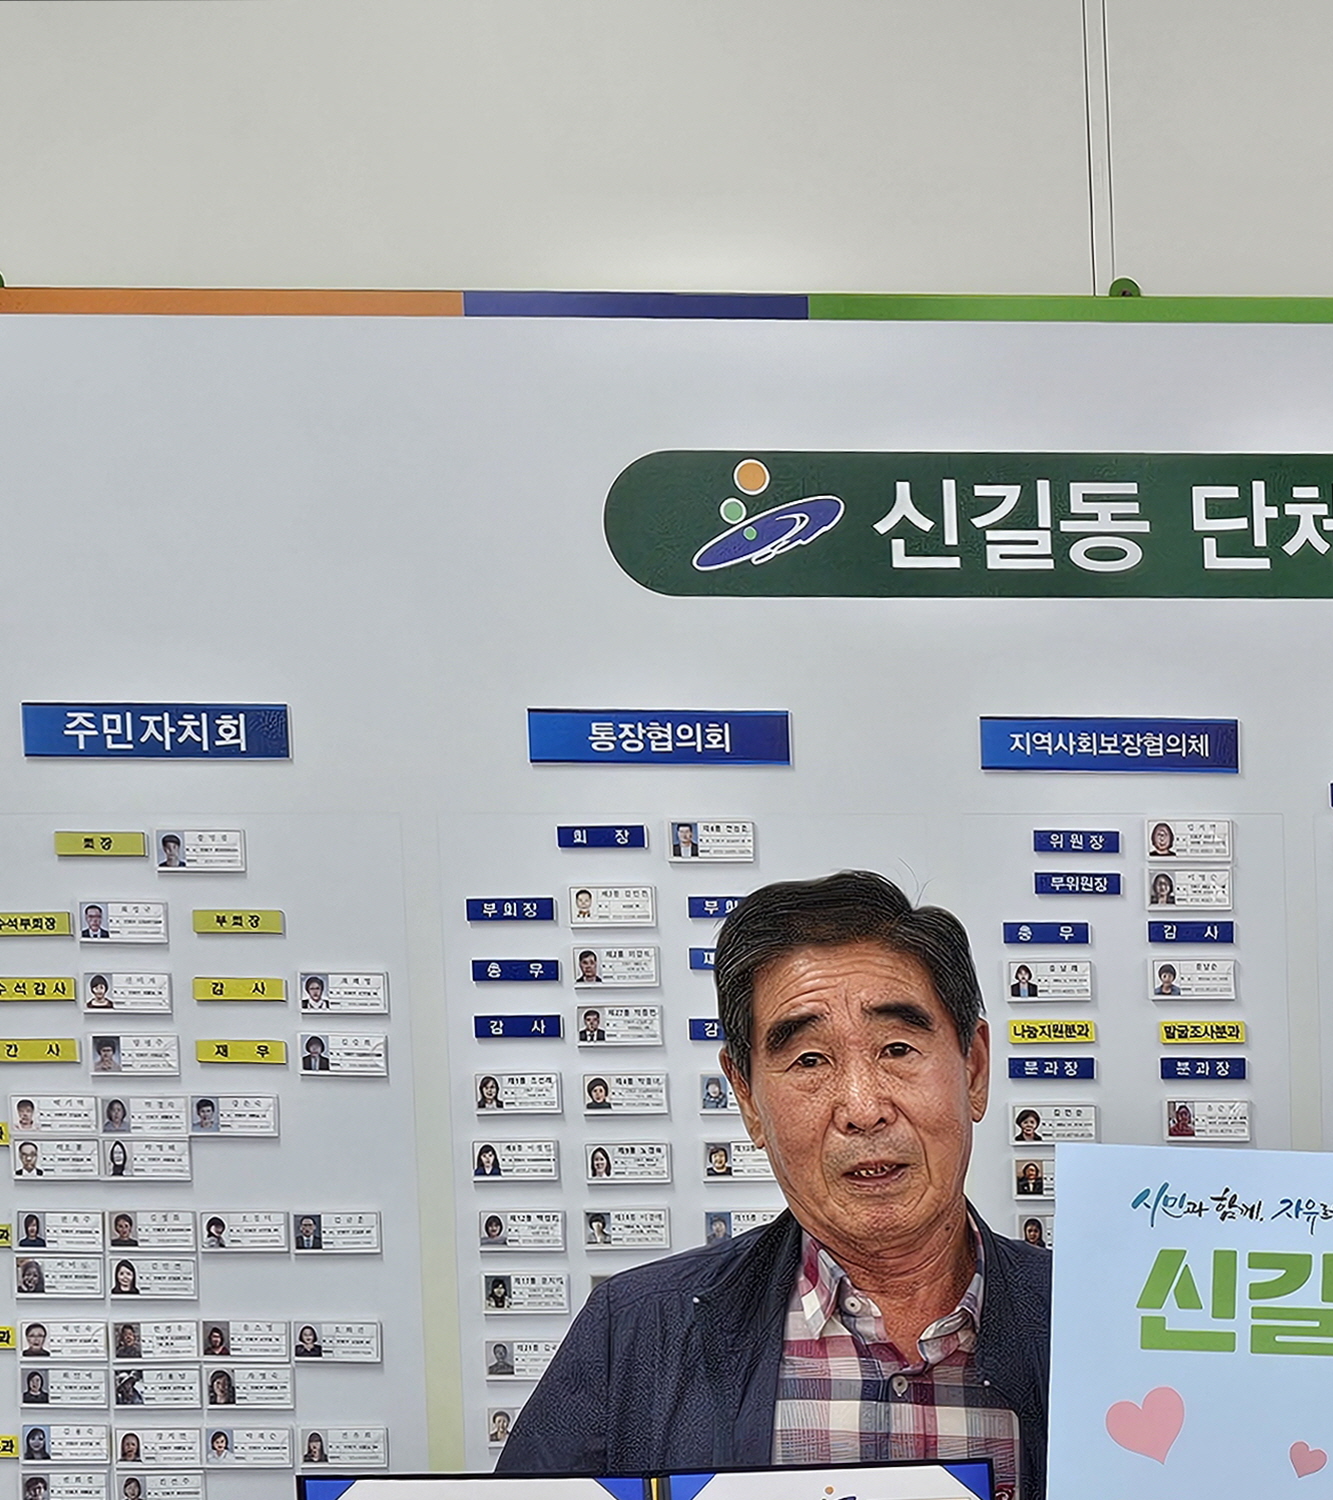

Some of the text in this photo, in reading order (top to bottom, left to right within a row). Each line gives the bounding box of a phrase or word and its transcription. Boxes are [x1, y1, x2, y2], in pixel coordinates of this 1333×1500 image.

[872, 477, 1149, 576] 신길동
[64, 711, 249, 752] 주민자치회
[589, 722, 732, 753] 통장협의회
[1010, 732, 1209, 758] 지역사회보장협의체
[1131, 1182, 1209, 1227] 시민과
